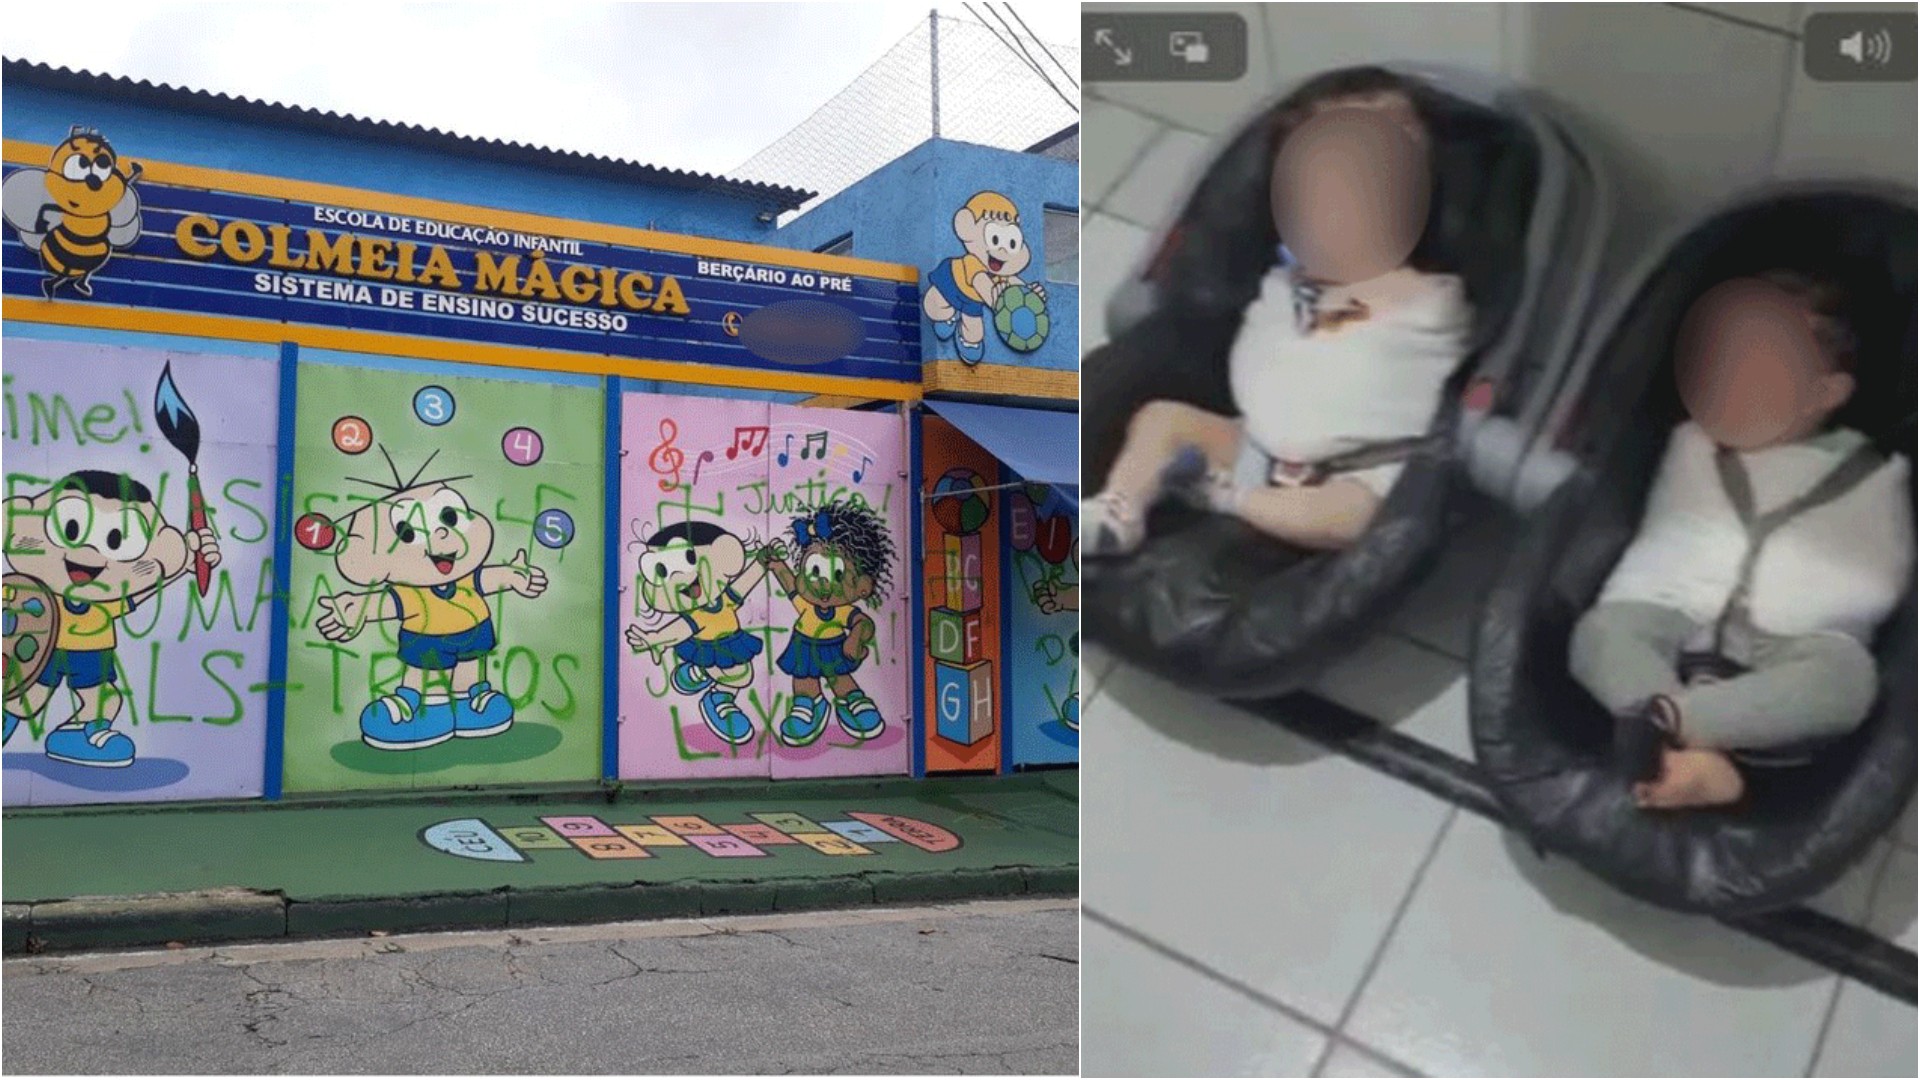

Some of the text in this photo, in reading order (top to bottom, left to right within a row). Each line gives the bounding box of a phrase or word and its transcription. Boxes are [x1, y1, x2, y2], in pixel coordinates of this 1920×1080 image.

[313, 206, 584, 256] ESCOLA DE EDUCAÇÃO INFANTIL
[175, 214, 690, 315] COLMEIA MÁGICA
[697, 260, 853, 292] BERÇÁRIO AO PRÉ
[254, 273, 628, 332] SISTEMA DE ENSINO SUCESSO
[425, 393, 444, 420] 3
[340, 424, 364, 447] 2
[512, 432, 533, 461] 4
[305, 521, 325, 545] 1
[544, 516, 564, 543] 5
[938, 618, 979, 659] D F
[940, 675, 992, 723] G H
[446, 829, 493, 853] CÉU
[590, 843, 626, 852] 8
